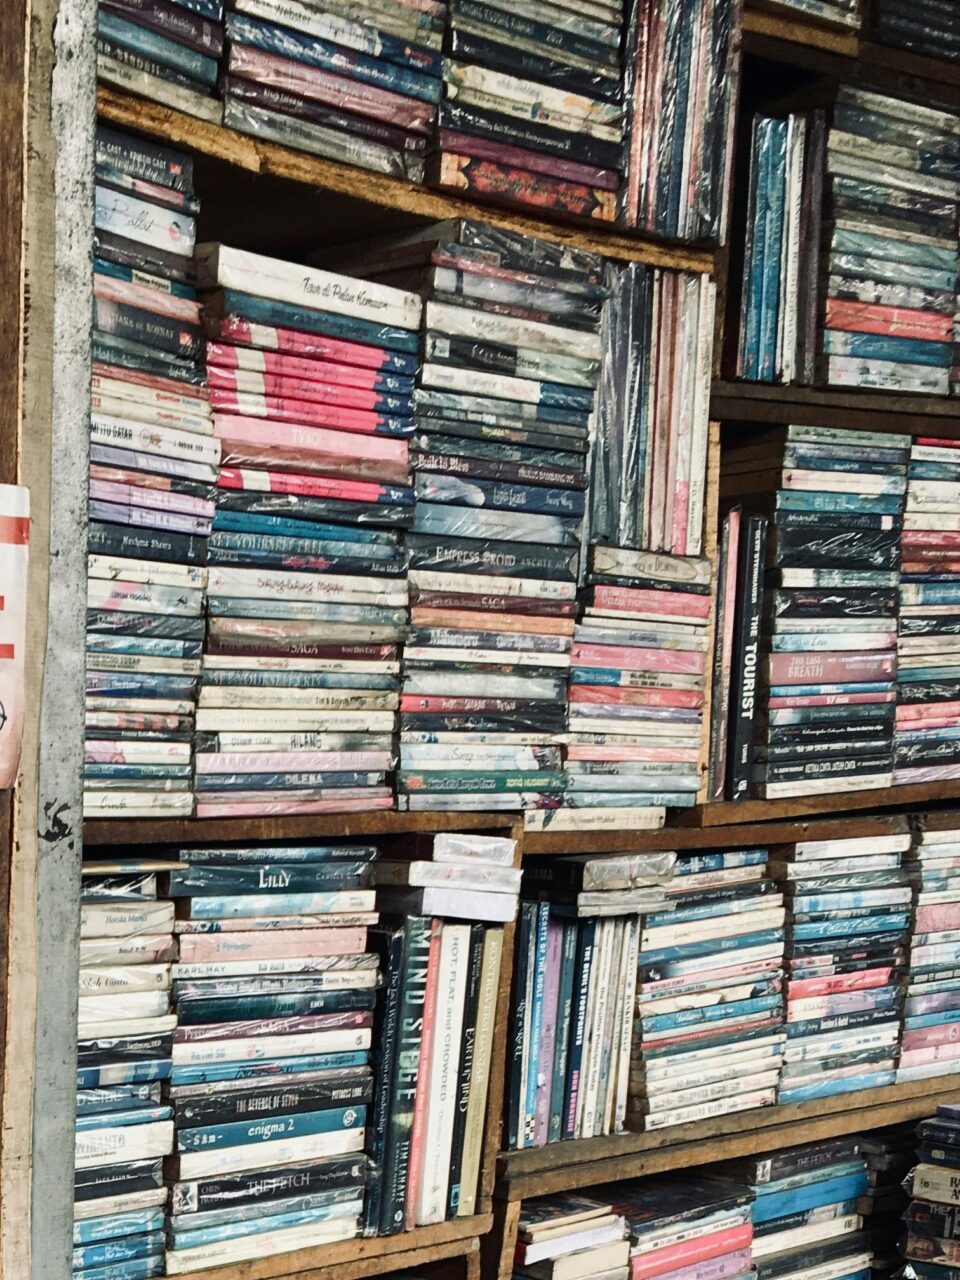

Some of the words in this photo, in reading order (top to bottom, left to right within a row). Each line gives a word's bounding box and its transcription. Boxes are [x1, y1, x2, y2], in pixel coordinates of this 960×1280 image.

[750, 615, 759, 636] THE
[741, 642, 758, 721] TOURIST
[404, 932, 431, 1003] MIND
[396, 1017, 422, 1101] SIEGE
[248, 1122, 285, 1139] enigma
[287, 1119, 295, 1130] 2
